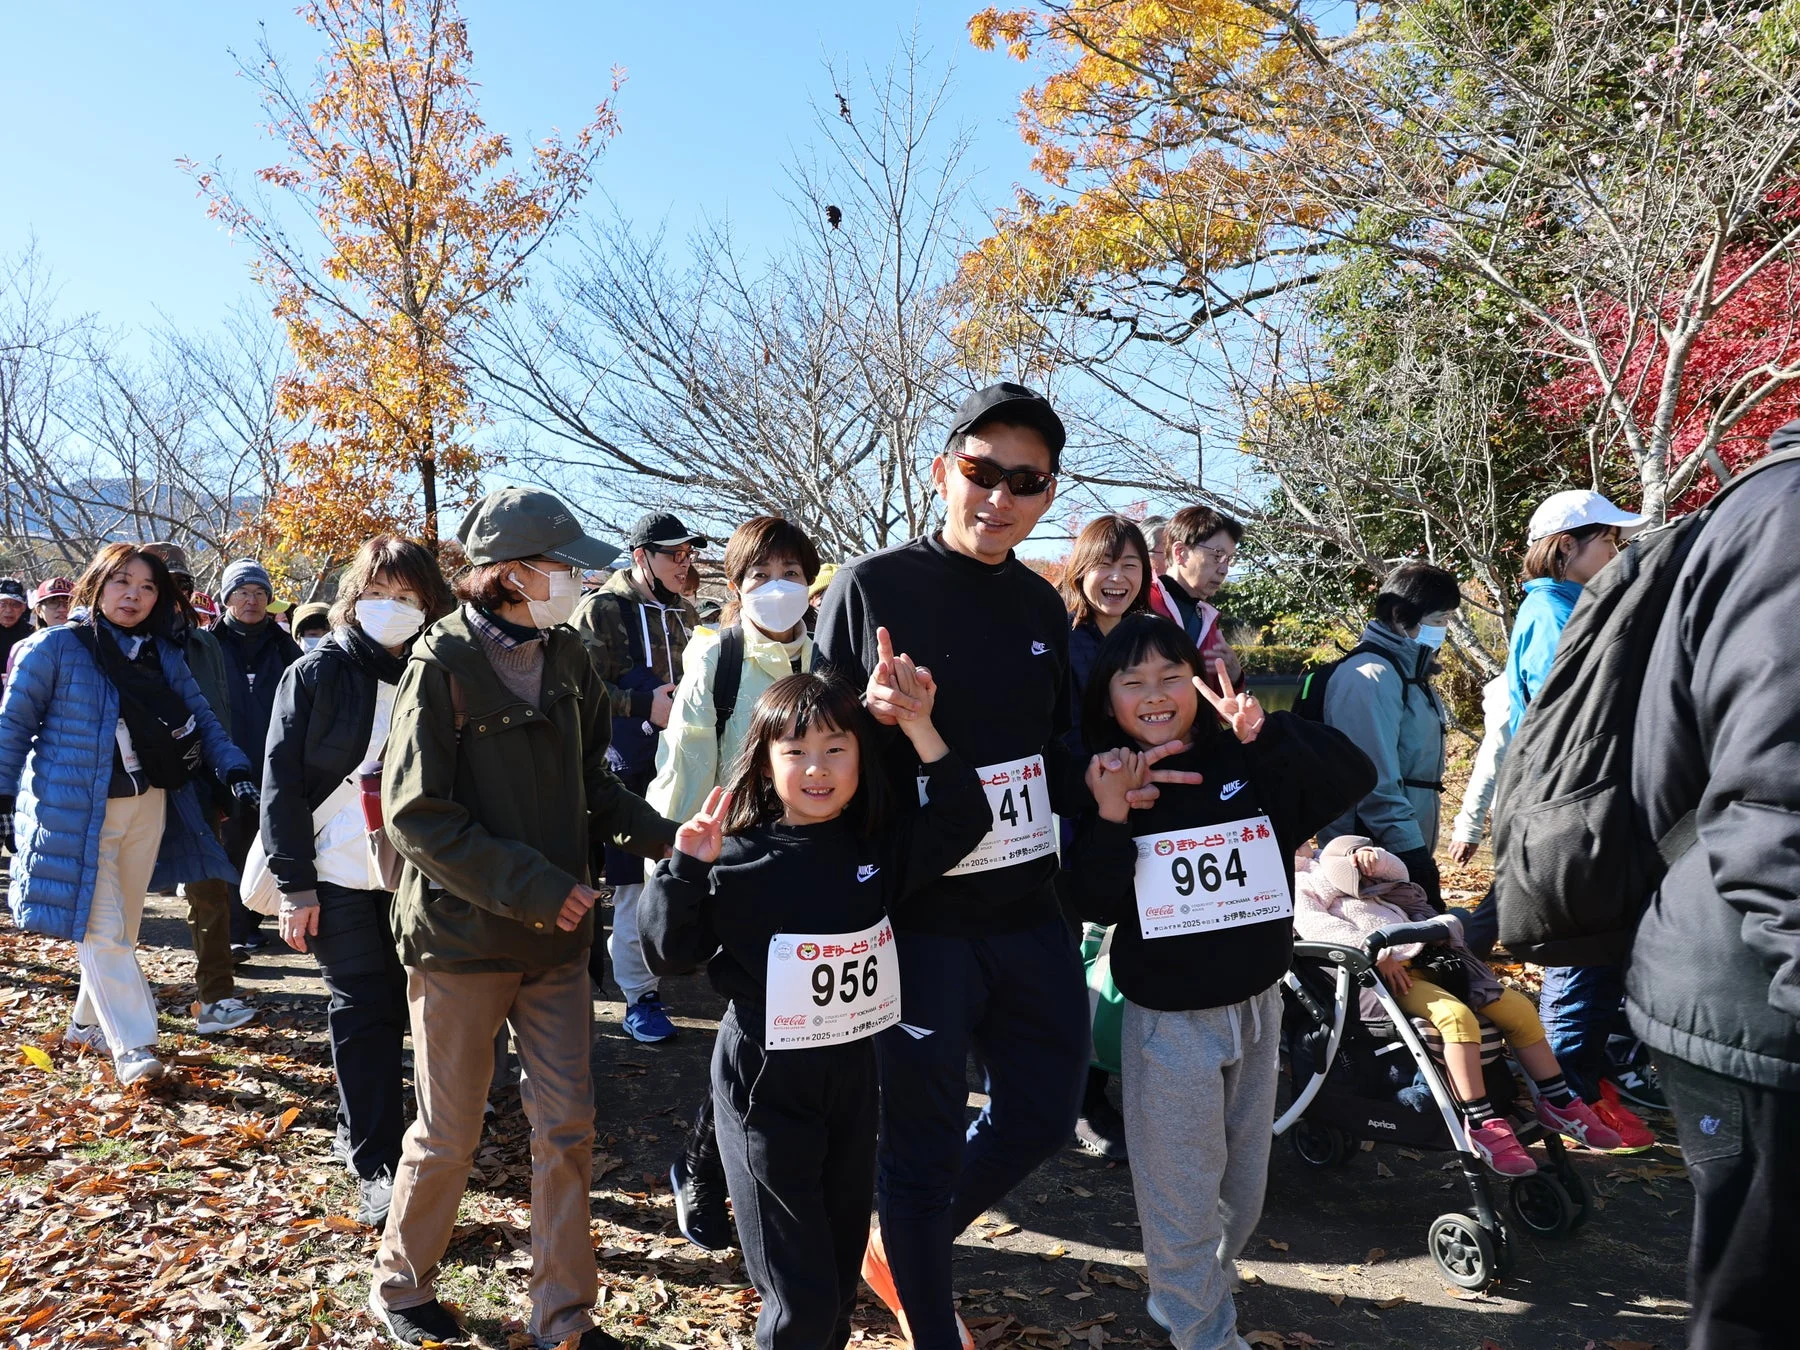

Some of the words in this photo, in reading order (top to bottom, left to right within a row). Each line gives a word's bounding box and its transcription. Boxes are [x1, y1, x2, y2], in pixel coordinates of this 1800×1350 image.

[1222, 779, 1241, 794] NIKE
[997, 784, 1034, 828] 41
[970, 858, 989, 868] 2025
[1171, 847, 1248, 897] 964
[1182, 919, 1201, 929] 2025
[1223, 905, 1281, 922] お伊勢さんマラソン
[811, 954, 878, 1007] 956
[811, 1031, 831, 1041] 2025
[1368, 1119, 1397, 1130] Aprica
